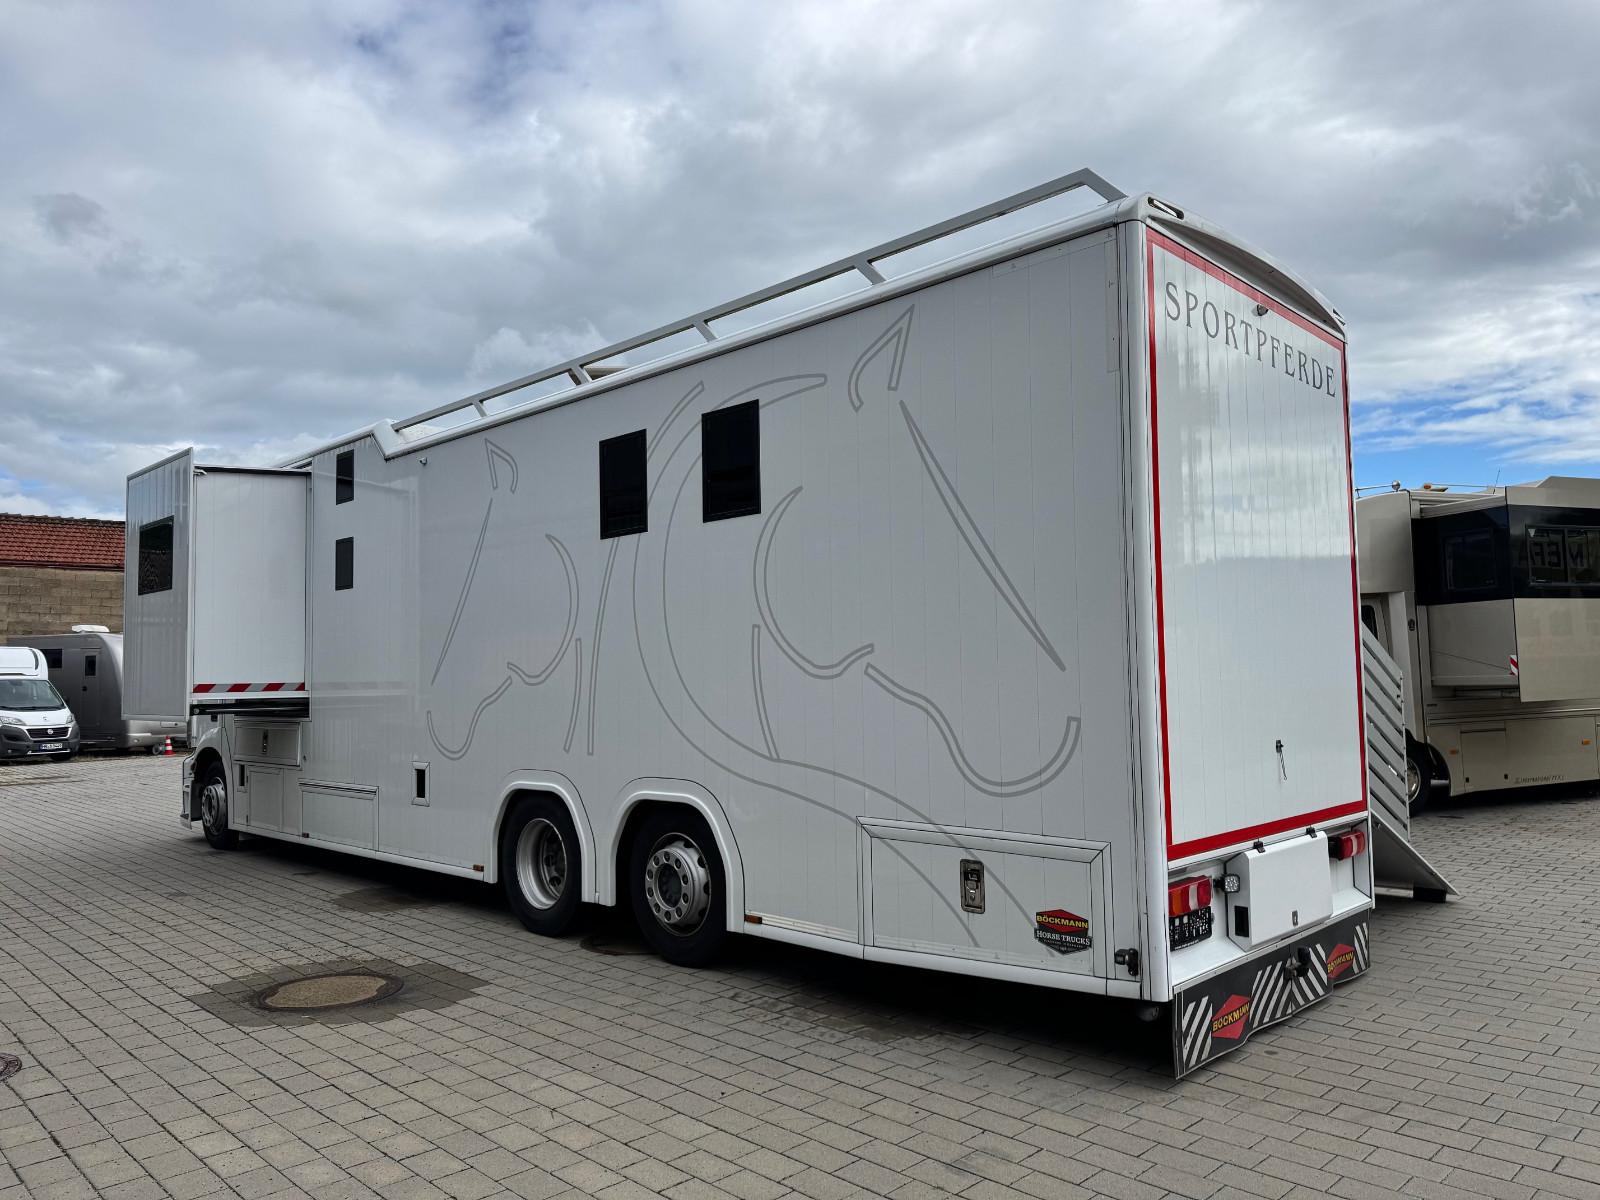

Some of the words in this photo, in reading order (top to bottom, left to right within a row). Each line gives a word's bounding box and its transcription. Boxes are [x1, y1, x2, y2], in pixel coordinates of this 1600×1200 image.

[1165, 281, 1336, 398] SPORTPFERDE
[1036, 914, 1088, 929] BÖCKMANN
[1036, 930, 1060, 941] HORSE
[1060, 934, 1090, 946] TRUCKS
